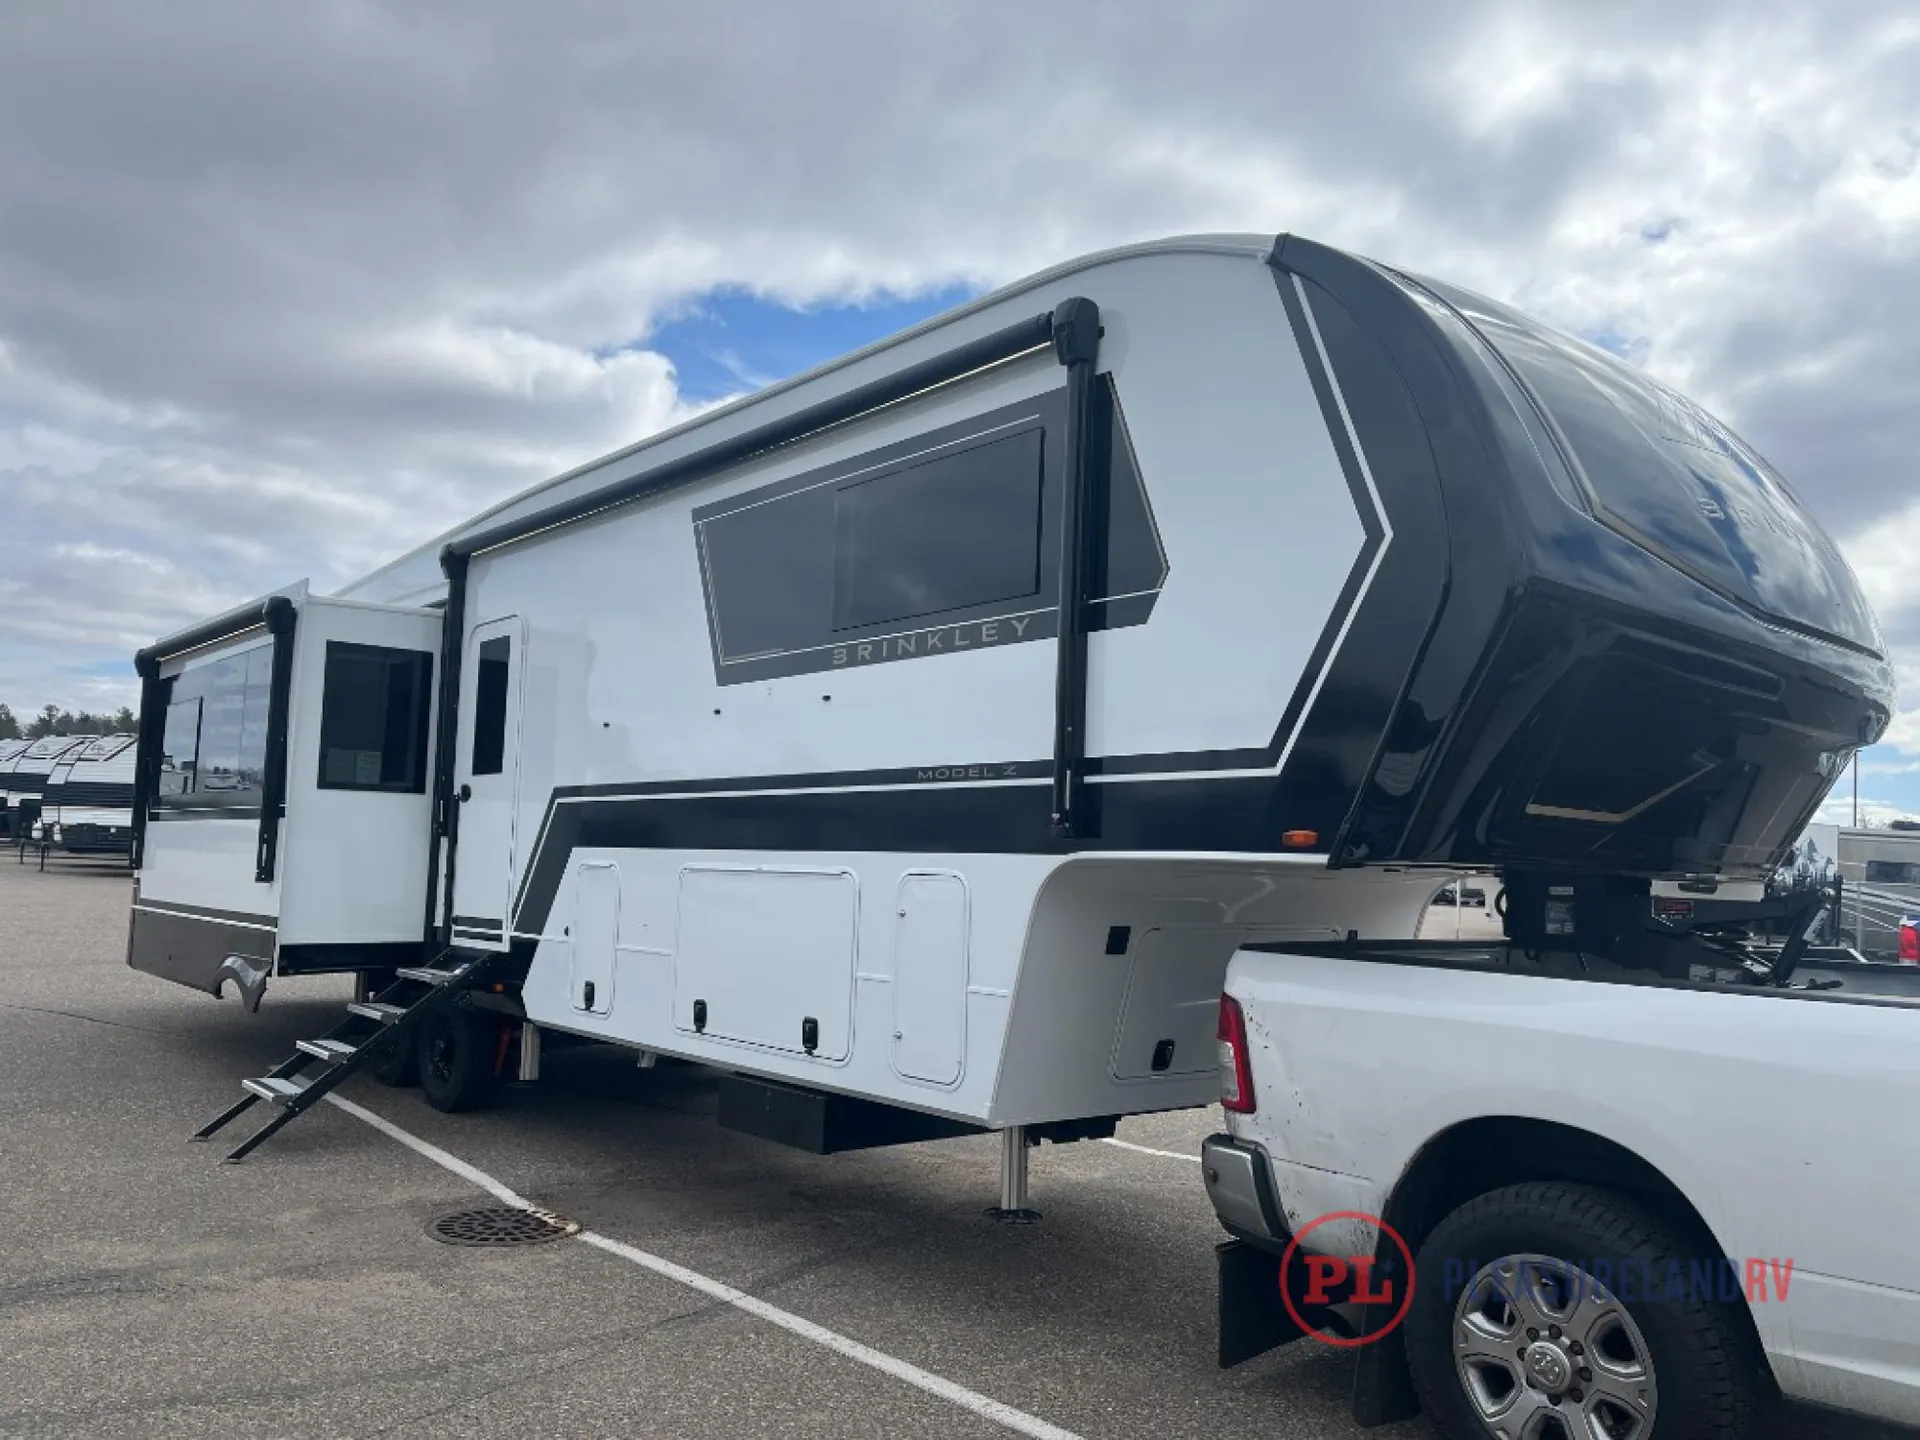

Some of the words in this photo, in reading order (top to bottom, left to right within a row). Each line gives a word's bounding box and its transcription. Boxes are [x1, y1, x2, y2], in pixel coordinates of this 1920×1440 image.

[832, 618, 1030, 665] BRINKLEY
[918, 767, 994, 779] MODEL
[1002, 763, 1017, 776] Z
